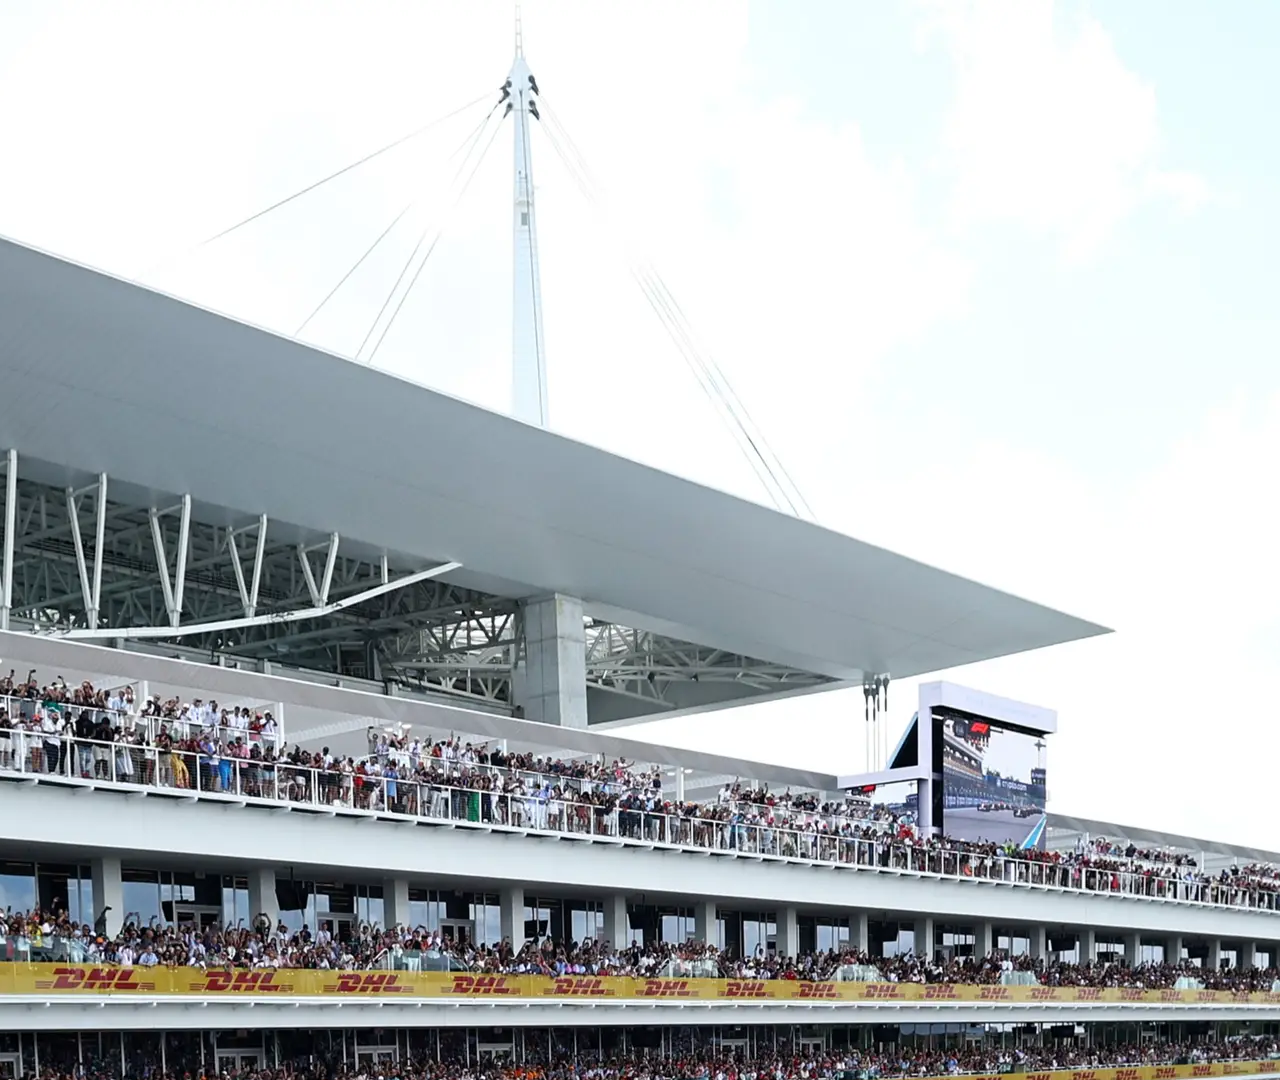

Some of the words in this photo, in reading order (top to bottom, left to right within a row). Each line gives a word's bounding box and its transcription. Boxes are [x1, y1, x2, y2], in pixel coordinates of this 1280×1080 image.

[53, 968, 141, 990] DHL
[204, 971, 281, 992] DHL
[336, 974, 399, 993] DHL
[453, 976, 509, 994] DHL
[554, 979, 606, 995] DHL
[644, 980, 690, 996] DHL
[726, 982, 767, 997] DHL
[798, 983, 836, 998] DHL
[865, 984, 899, 998] DHL
[925, 985, 957, 998] DHL
[980, 987, 1009, 999] DHL
[1031, 988, 1056, 999] DHL
[1078, 988, 1102, 1000] DHL
